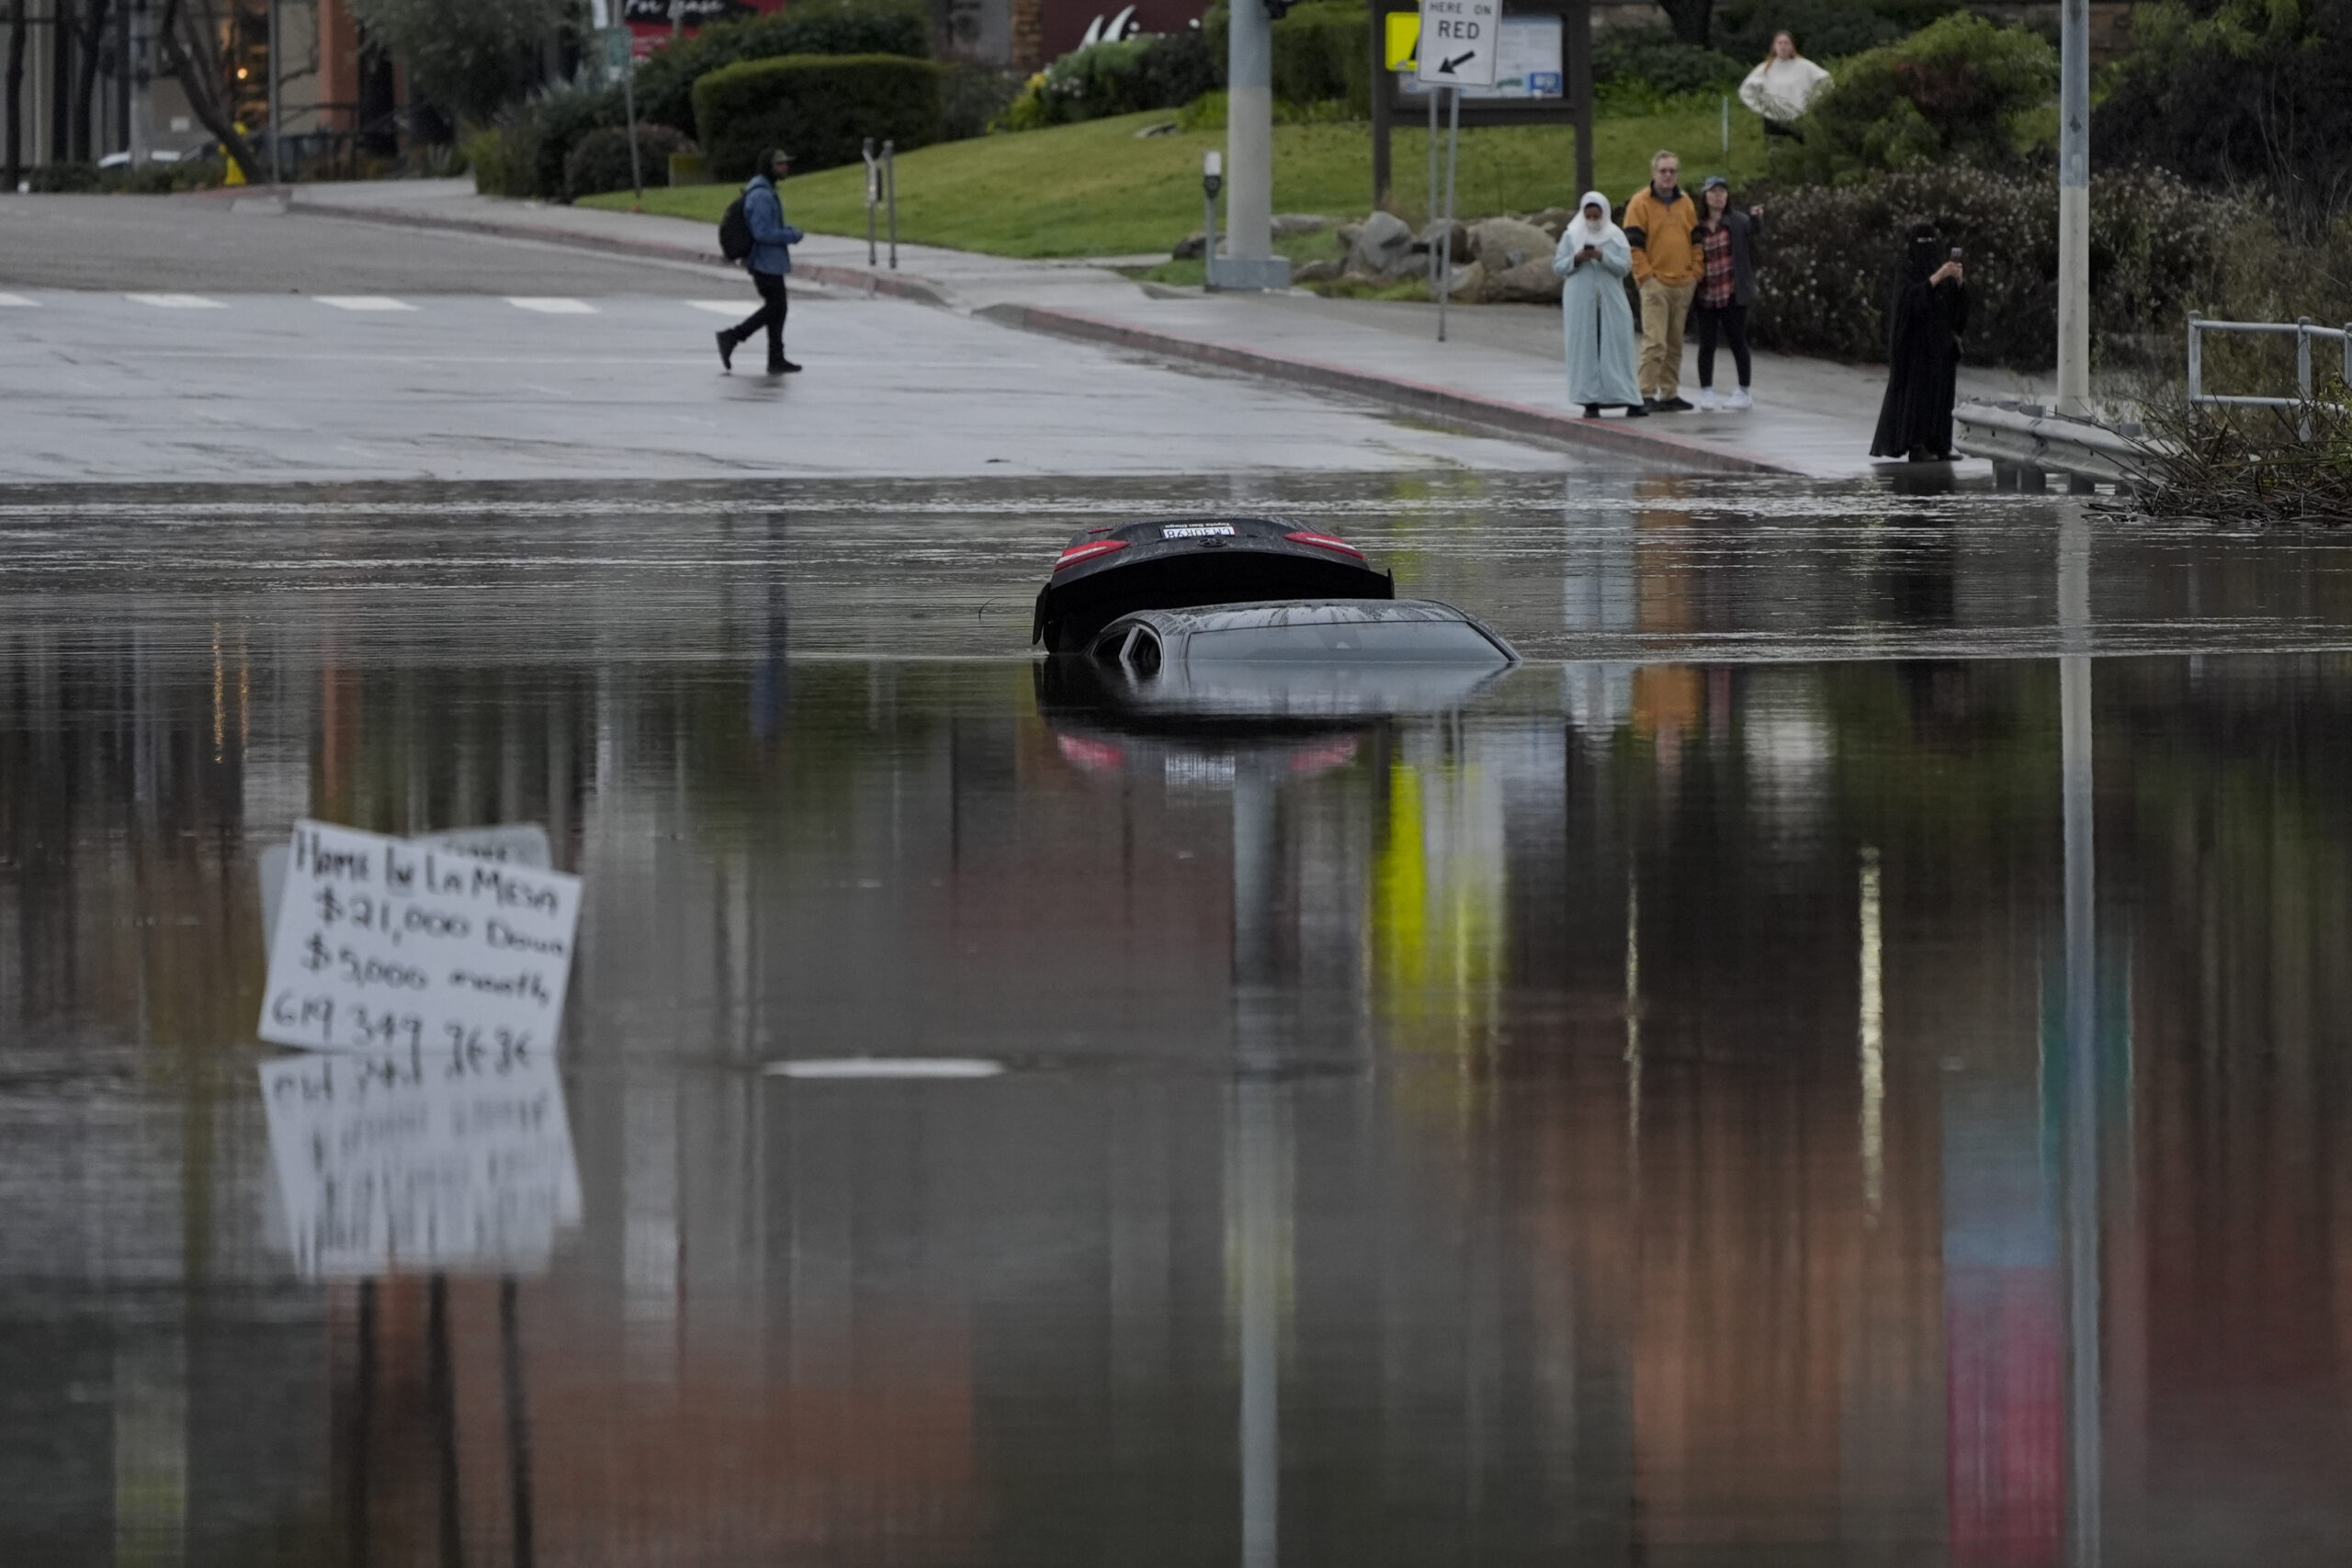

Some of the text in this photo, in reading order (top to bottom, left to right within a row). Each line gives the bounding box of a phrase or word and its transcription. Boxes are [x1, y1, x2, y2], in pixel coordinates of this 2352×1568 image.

[1429, 1, 1492, 15] HERE ON
[1438, 19, 1480, 39] RED
[273, 988, 334, 1041] 619
